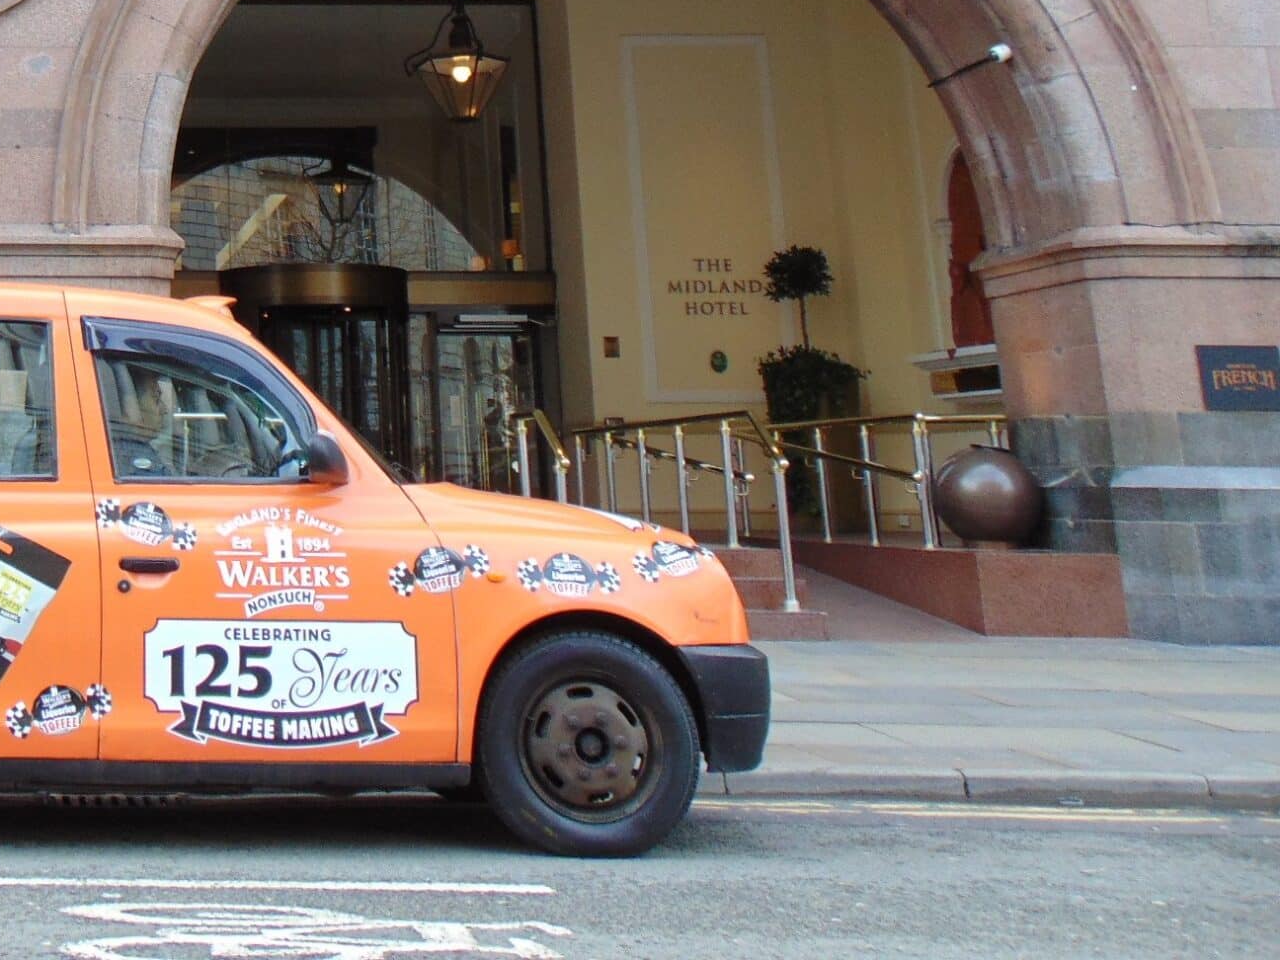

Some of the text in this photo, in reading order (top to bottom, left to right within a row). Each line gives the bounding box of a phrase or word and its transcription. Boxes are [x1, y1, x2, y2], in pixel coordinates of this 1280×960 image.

[693, 258, 733, 272] THE
[668, 280, 763, 294] MIDLAND
[685, 302, 749, 316] HOTEL
[297, 538, 331, 551] 1894
[216, 560, 350, 588] WALKER'S
[247, 591, 312, 615] NONSUCH
[224, 627, 332, 642] CELEBRATING
[162, 644, 403, 709] 125 Years
[271, 698, 288, 710] OF
[43, 717, 77, 733] TOFFEE
[208, 710, 358, 740] TOFFEE MAKING
